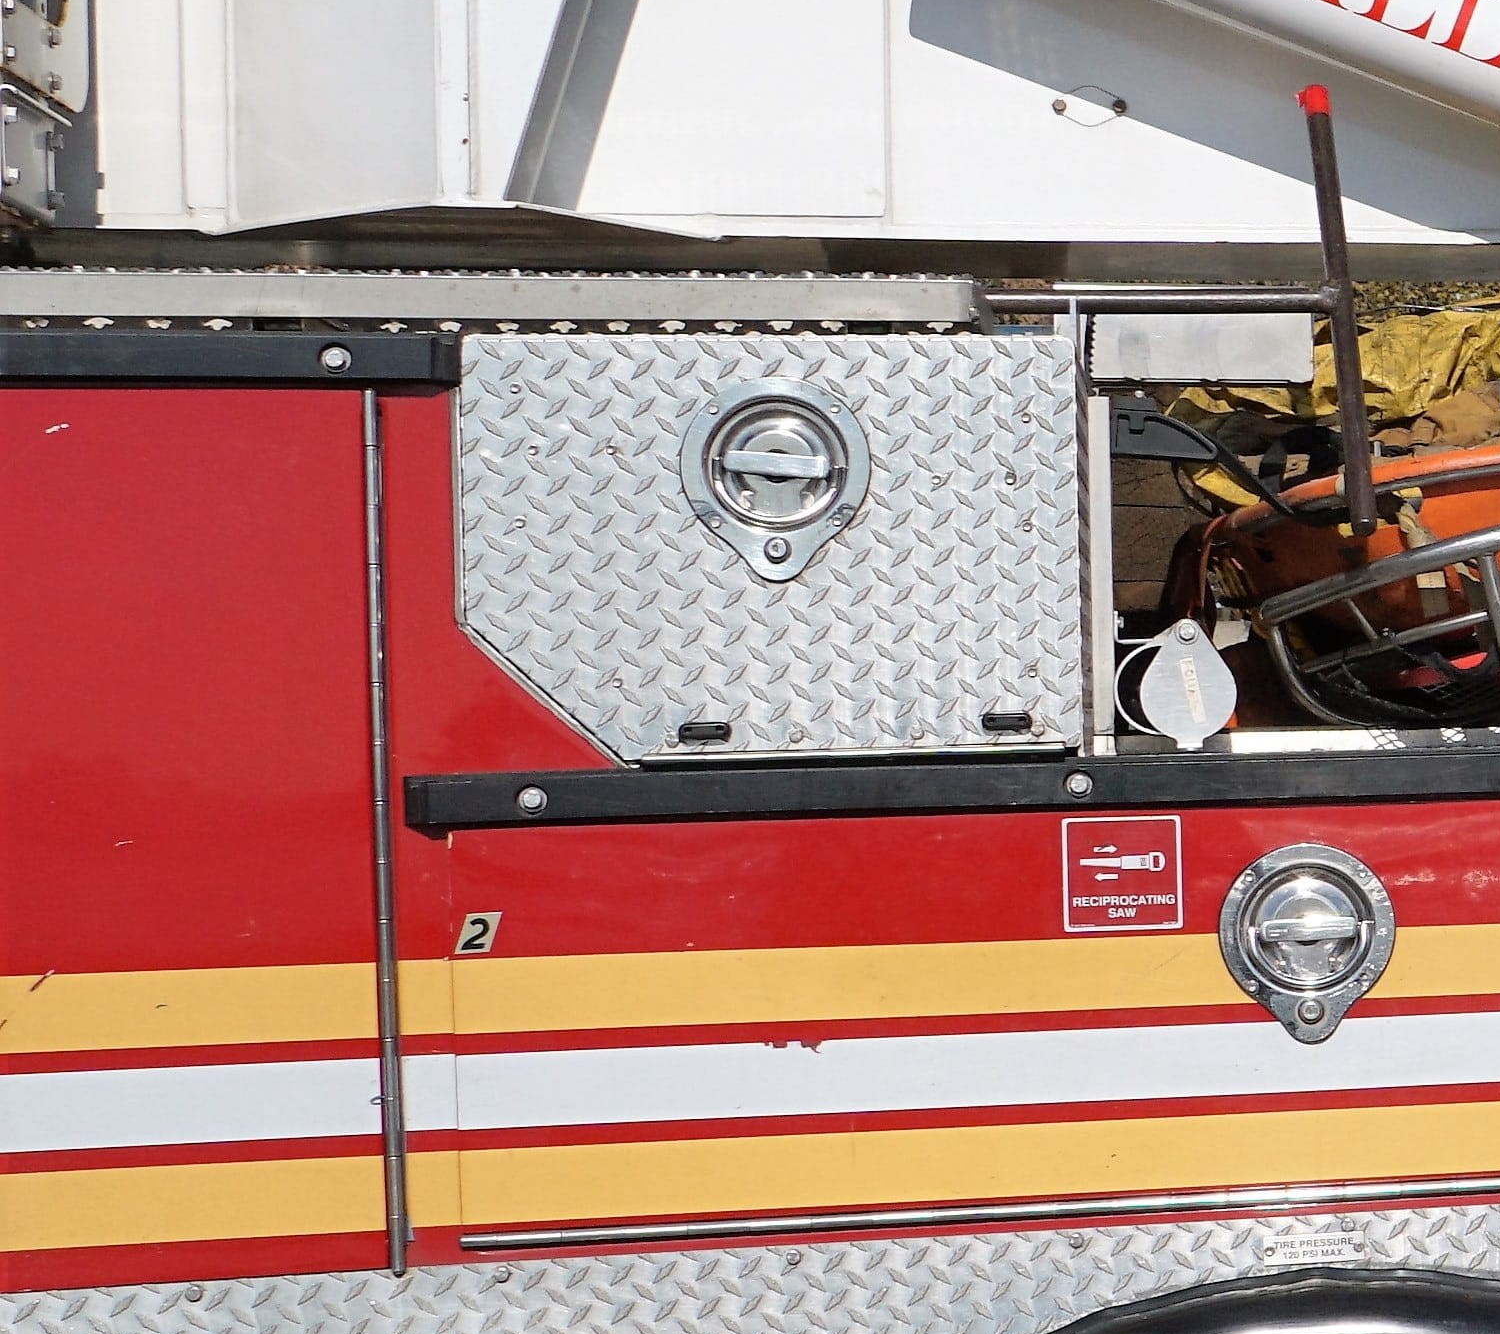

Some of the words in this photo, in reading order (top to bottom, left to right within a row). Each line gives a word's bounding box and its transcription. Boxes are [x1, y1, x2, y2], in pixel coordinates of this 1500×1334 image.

[1072, 894, 1176, 907] RECIPROCATING
[1108, 908, 1137, 918] SAW
[461, 918, 490, 950] 2
[1273, 1240, 1296, 1250] TIRE
[1299, 1237, 1354, 1247] PRESSURE
[1302, 1250, 1318, 1258] PSI
